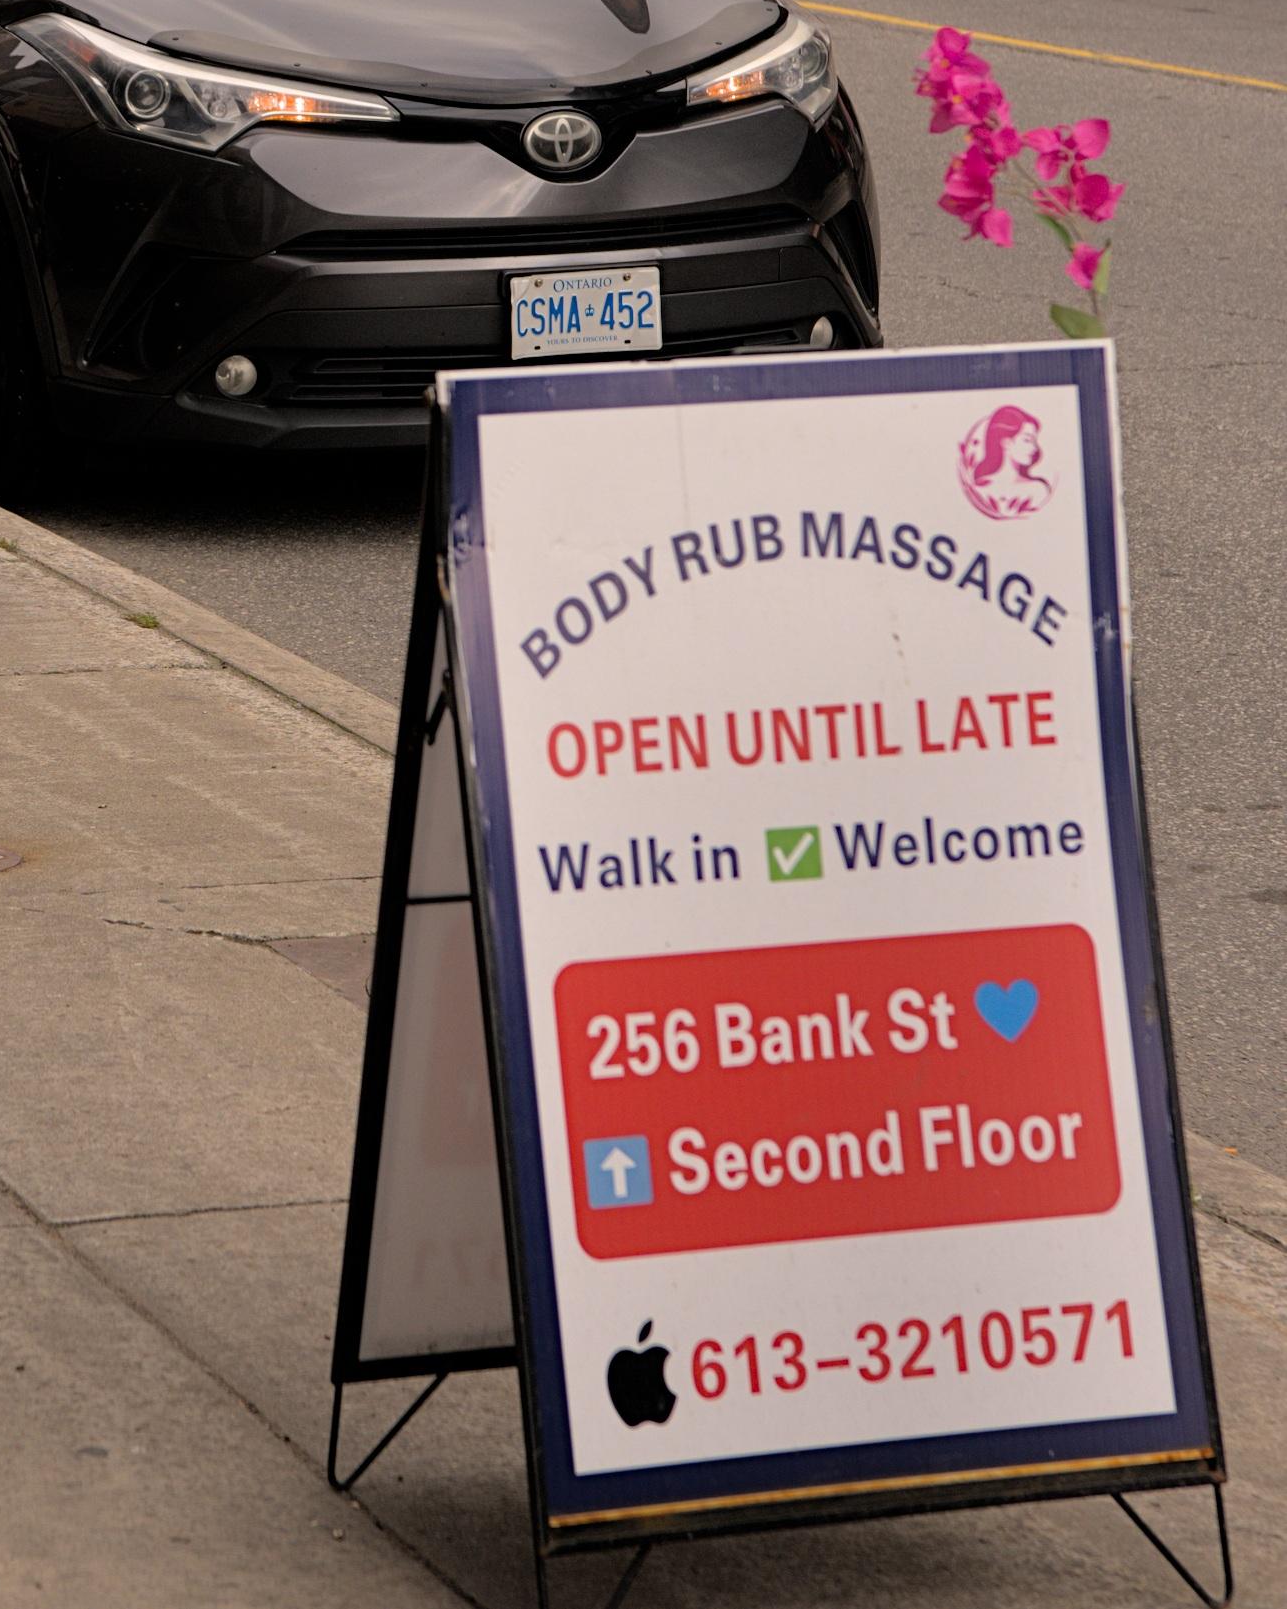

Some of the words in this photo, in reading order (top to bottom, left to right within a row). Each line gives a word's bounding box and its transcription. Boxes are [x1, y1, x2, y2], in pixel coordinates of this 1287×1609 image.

[516, 295, 582, 338] CSMA
[600, 290, 655, 331] 452
[553, 277, 612, 293] ONTARIO
[572, 336, 581, 344] TO
[583, 334, 618, 343] DISCOVER
[521, 548, 655, 678] BODY
[672, 515, 784, 582] RUB
[801, 511, 1068, 647] MASSAGE
[546, 713, 710, 780] OPEN
[724, 701, 902, 767] UNTIL
[915, 690, 1058, 755] LATE
[538, 837, 676, 892] Walk
[692, 834, 741, 882] in
[833, 816, 1085, 871] Welcome
[586, 1008, 700, 1079] 256
[714, 993, 873, 1068] Bank
[888, 988, 958, 1053] St
[668, 1110, 904, 1194] Second
[919, 1104, 1083, 1171] Floor
